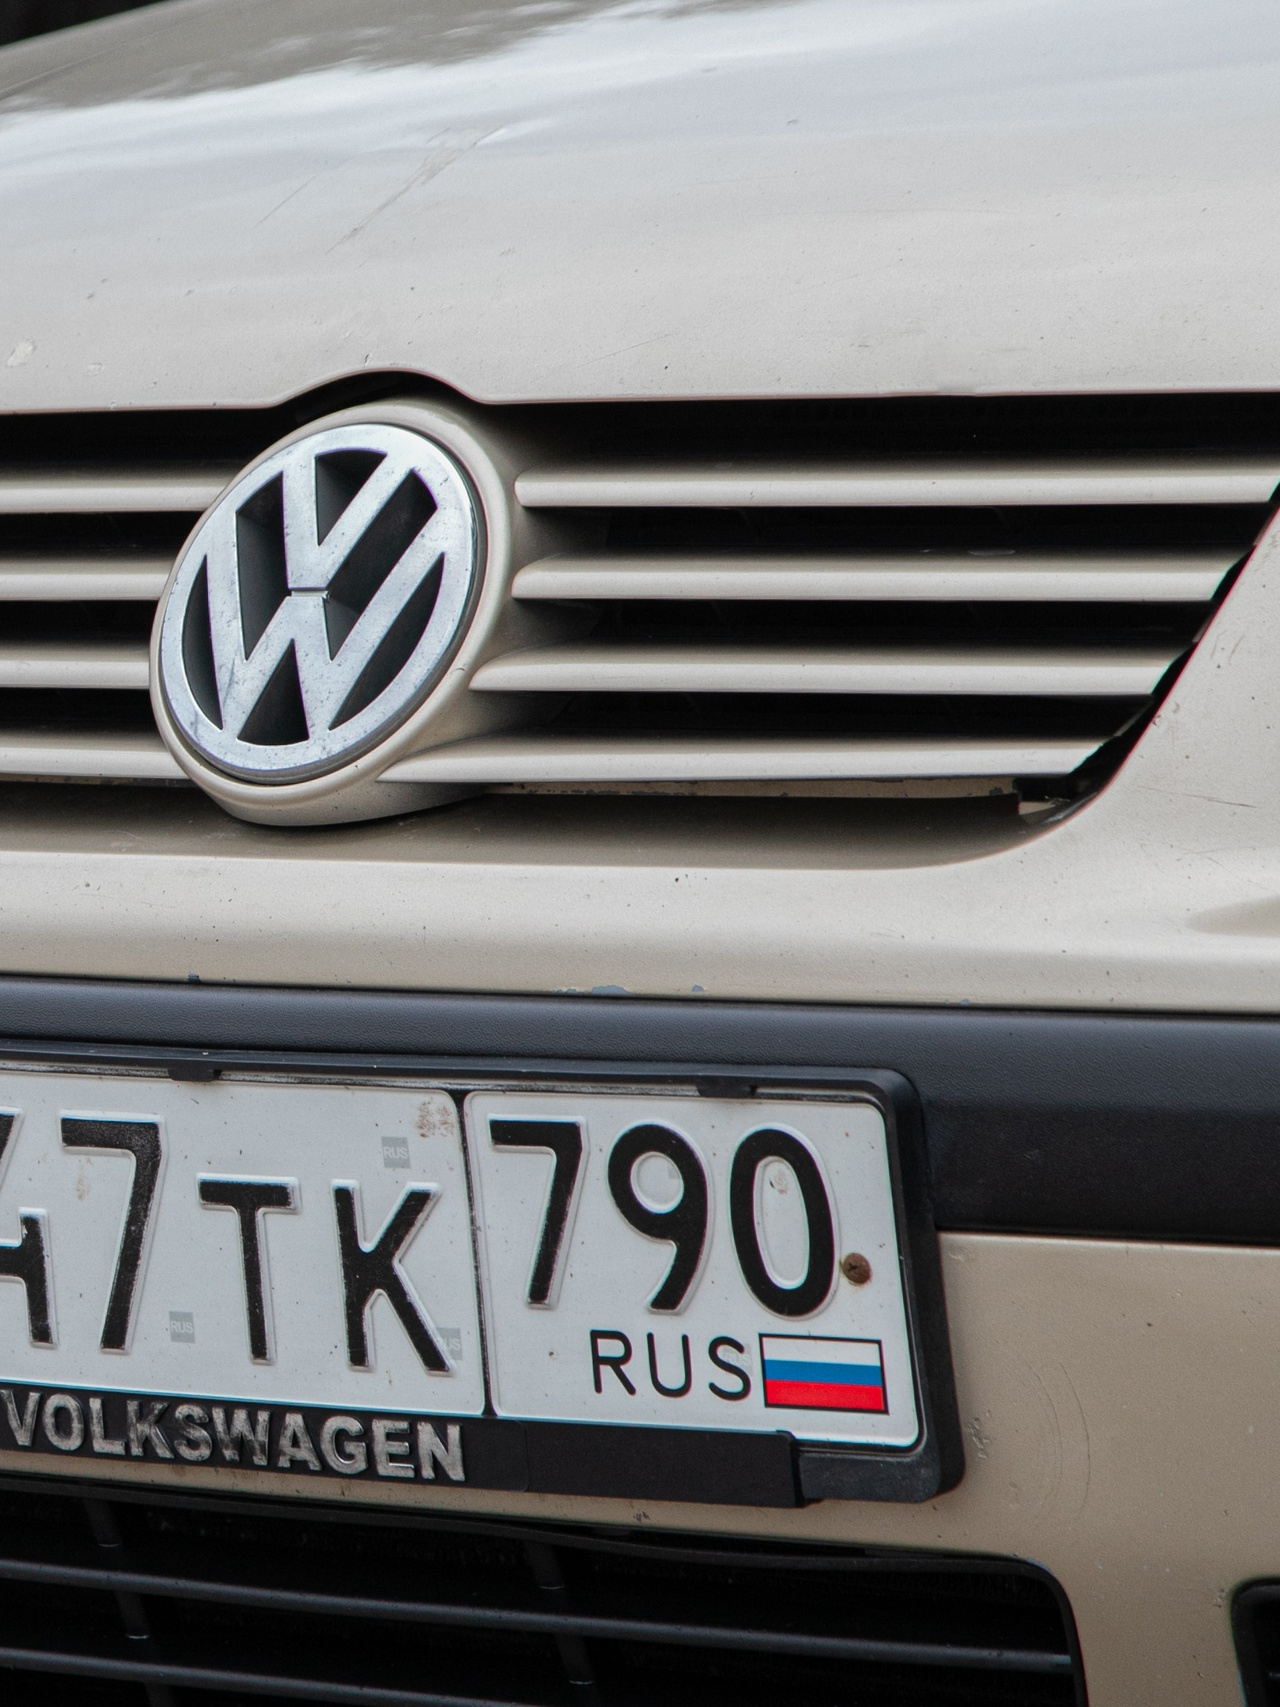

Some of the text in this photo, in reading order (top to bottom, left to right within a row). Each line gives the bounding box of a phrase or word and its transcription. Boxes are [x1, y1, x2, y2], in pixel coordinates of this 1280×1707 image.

[488, 1117, 837, 1318] 790
[590, 1329, 751, 1401] RUS
[0, 1389, 465, 1482] VOLKSWAGEN
